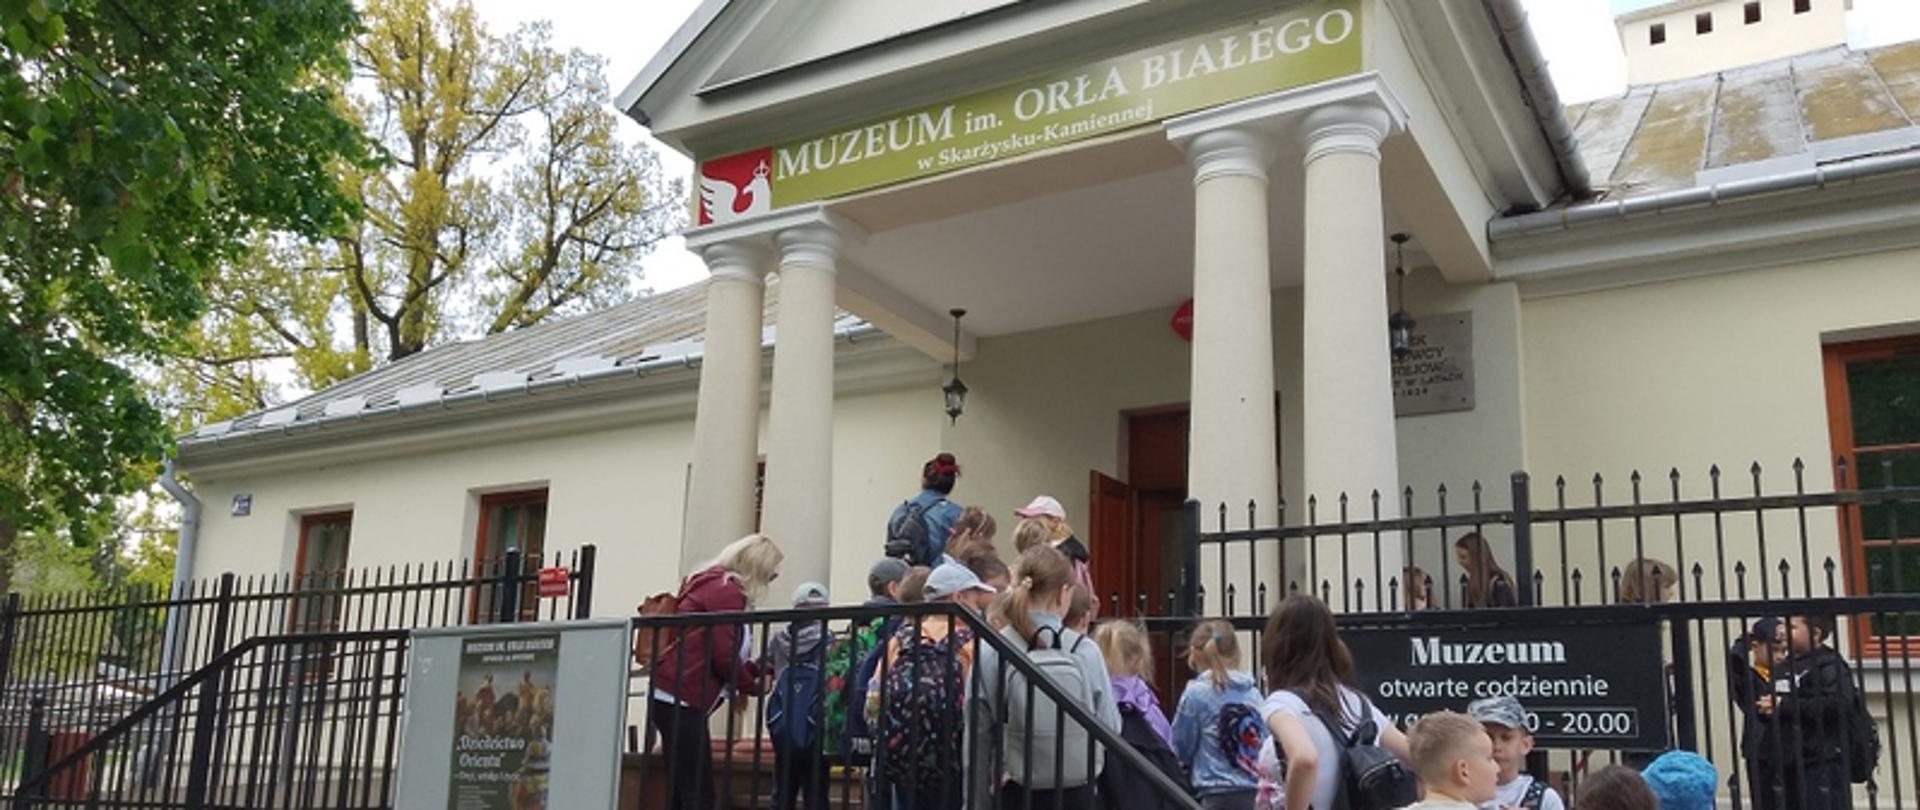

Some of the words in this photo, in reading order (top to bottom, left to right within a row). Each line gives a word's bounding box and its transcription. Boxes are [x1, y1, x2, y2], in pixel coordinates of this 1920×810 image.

[776, 105, 955, 180] MUZEUM
[964, 112, 1003, 135] im.
[1014, 64, 1128, 122] ORŁA
[1141, 8, 1354, 90] BIAŁEGO
[917, 156, 934, 170] w
[938, 101, 1153, 166] Skarżysku-Kamiennej
[1410, 637, 1566, 665] Muzeum
[1379, 678, 1469, 698] otwarte
[1475, 674, 1608, 697] codziennie
[1562, 712, 1630, 733] 20.00
